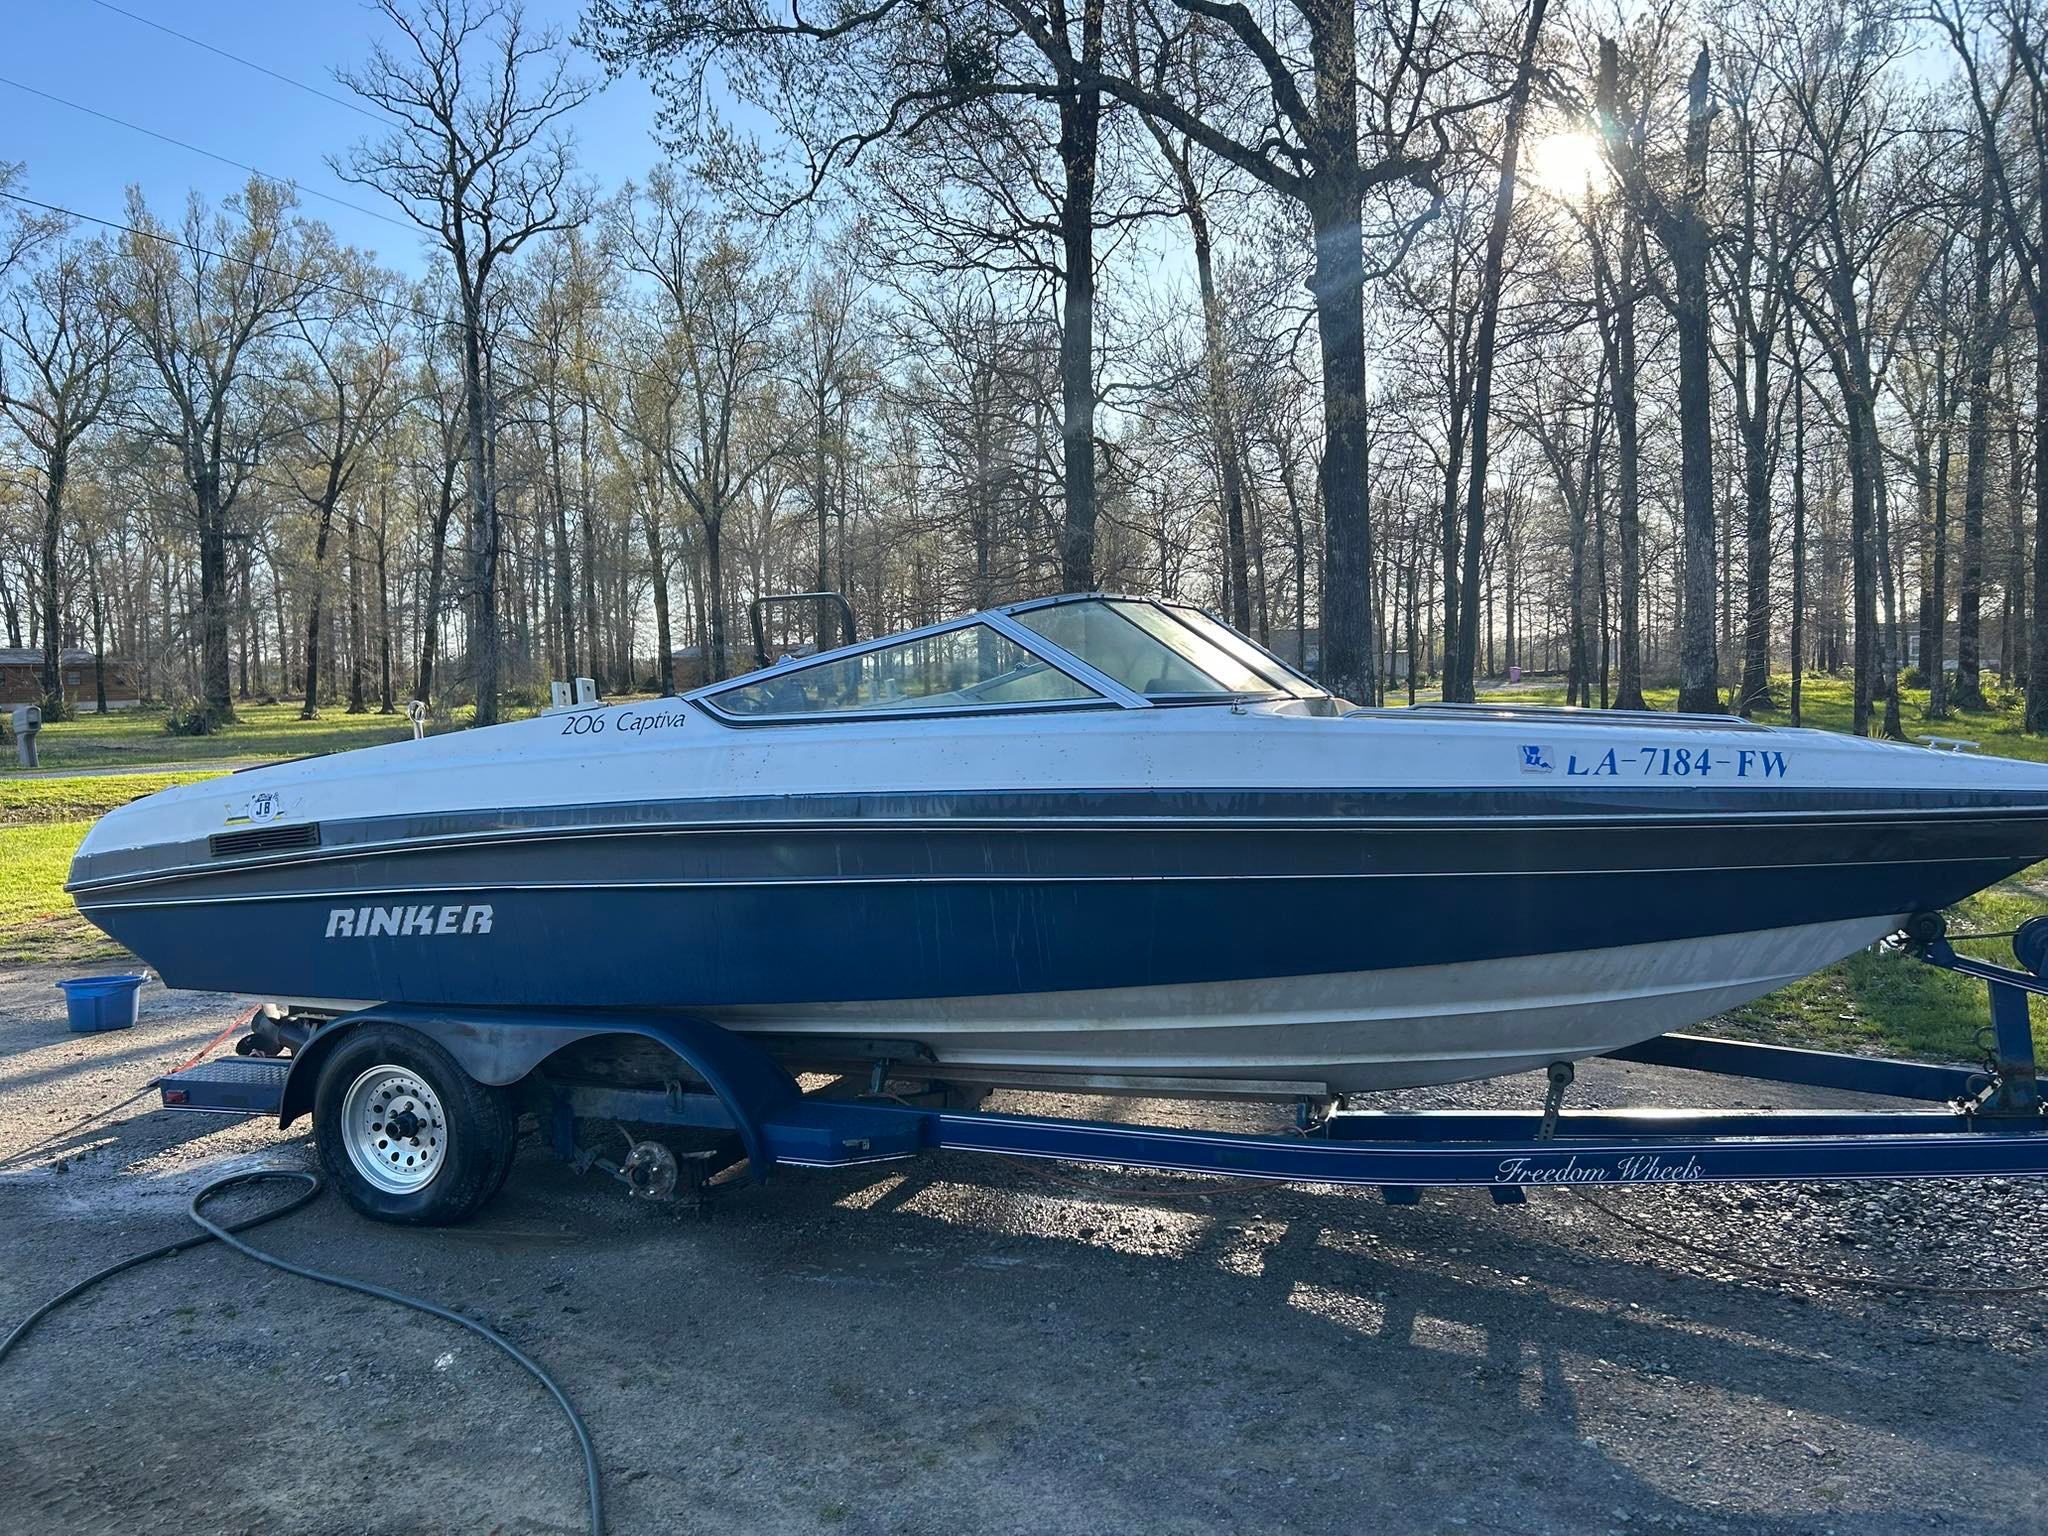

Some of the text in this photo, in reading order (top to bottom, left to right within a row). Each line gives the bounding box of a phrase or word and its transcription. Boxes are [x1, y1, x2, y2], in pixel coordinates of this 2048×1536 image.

[561, 711, 686, 735] 206 Captiva
[325, 904, 493, 937] RINKER
[1494, 1154, 1706, 1183] Freedom Wheels
